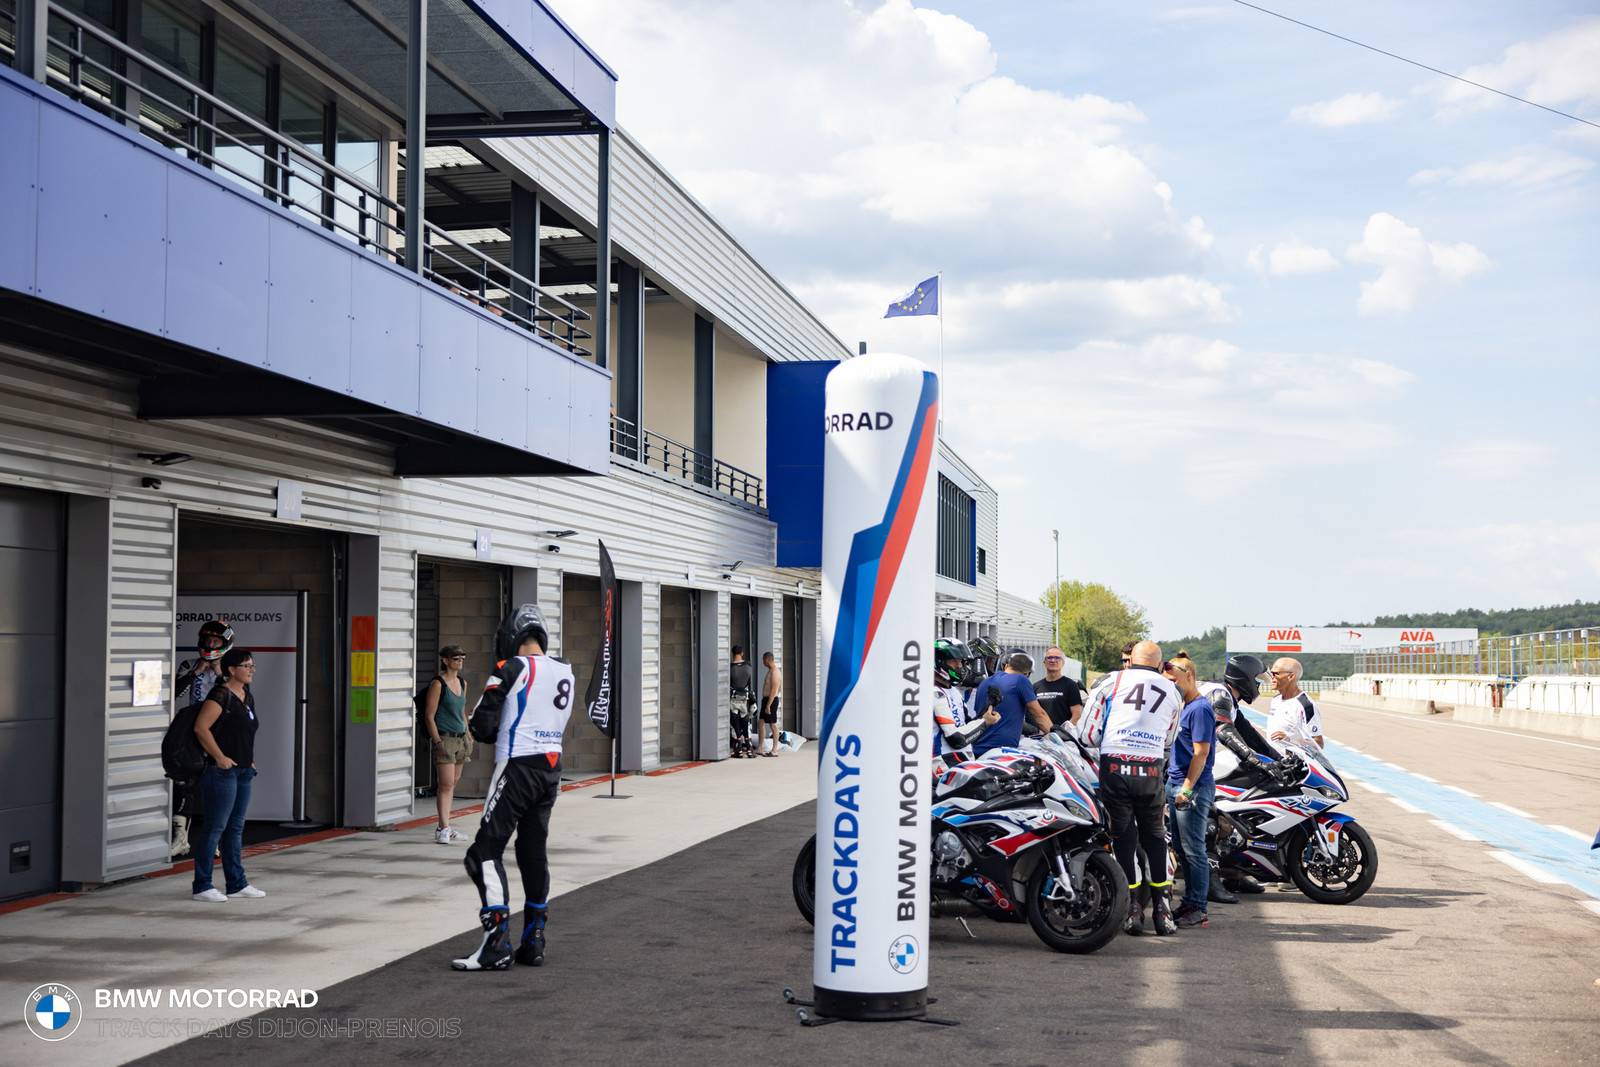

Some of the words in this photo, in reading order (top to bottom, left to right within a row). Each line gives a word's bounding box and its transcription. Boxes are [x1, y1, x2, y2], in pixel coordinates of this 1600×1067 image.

[480, 535, 488, 553] 21
[216, 613, 252, 621] TRACK
[254, 613, 283, 622] DAYS
[553, 678, 571, 710] 8
[1123, 682, 1167, 714] 47
[900, 640, 921, 828] MOTORRAD
[1117, 729, 1162, 743] TRACKDAYS
[831, 733, 861, 973] TRACKDAYS
[897, 838, 917, 922] BMW
